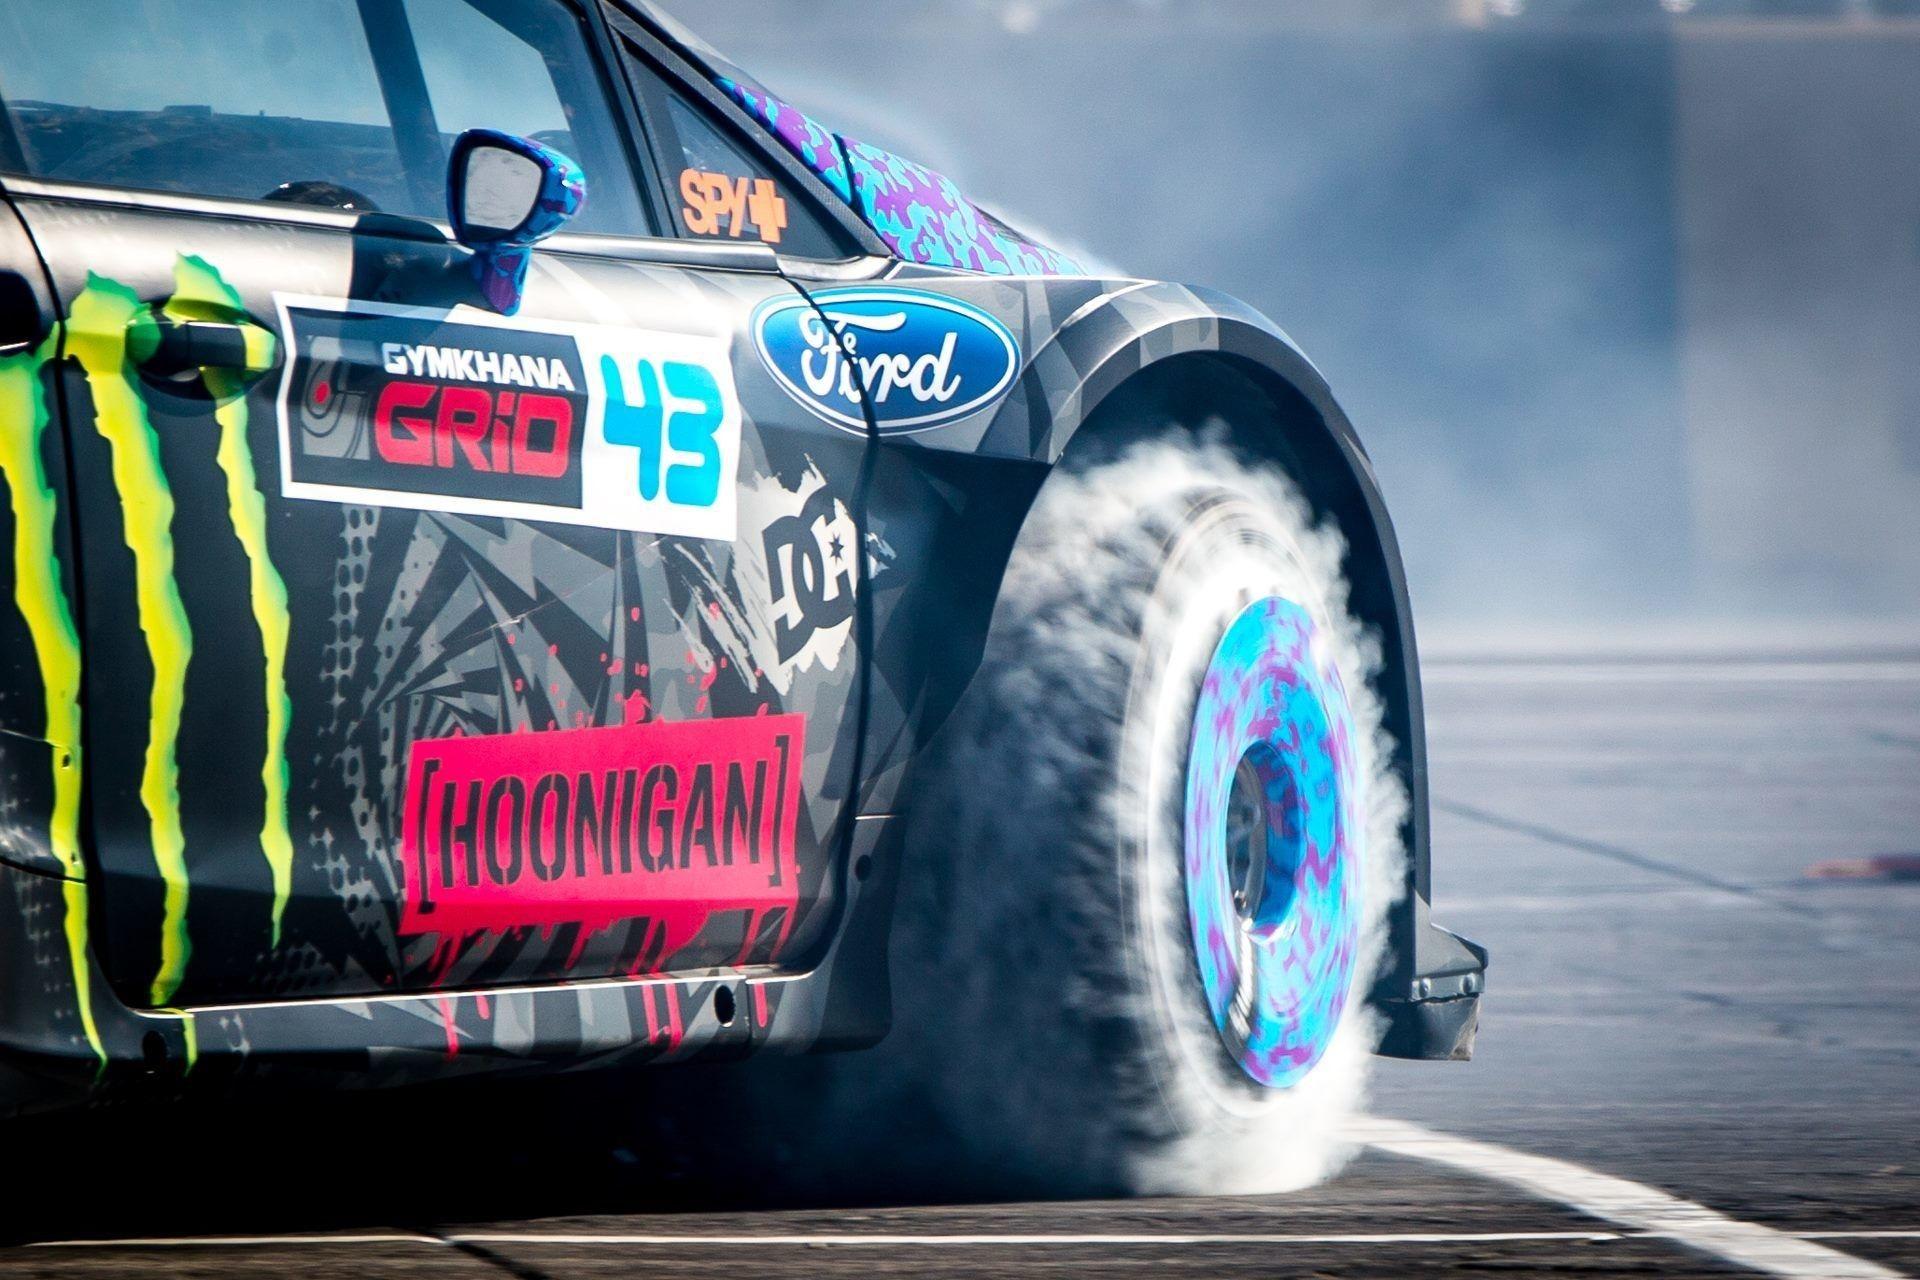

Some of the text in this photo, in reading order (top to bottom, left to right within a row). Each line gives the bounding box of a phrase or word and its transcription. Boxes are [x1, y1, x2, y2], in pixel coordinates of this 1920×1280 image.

[383, 342, 575, 391] GYMKHANA
[797, 307, 963, 408] Ford
[601, 352, 724, 508] 43
